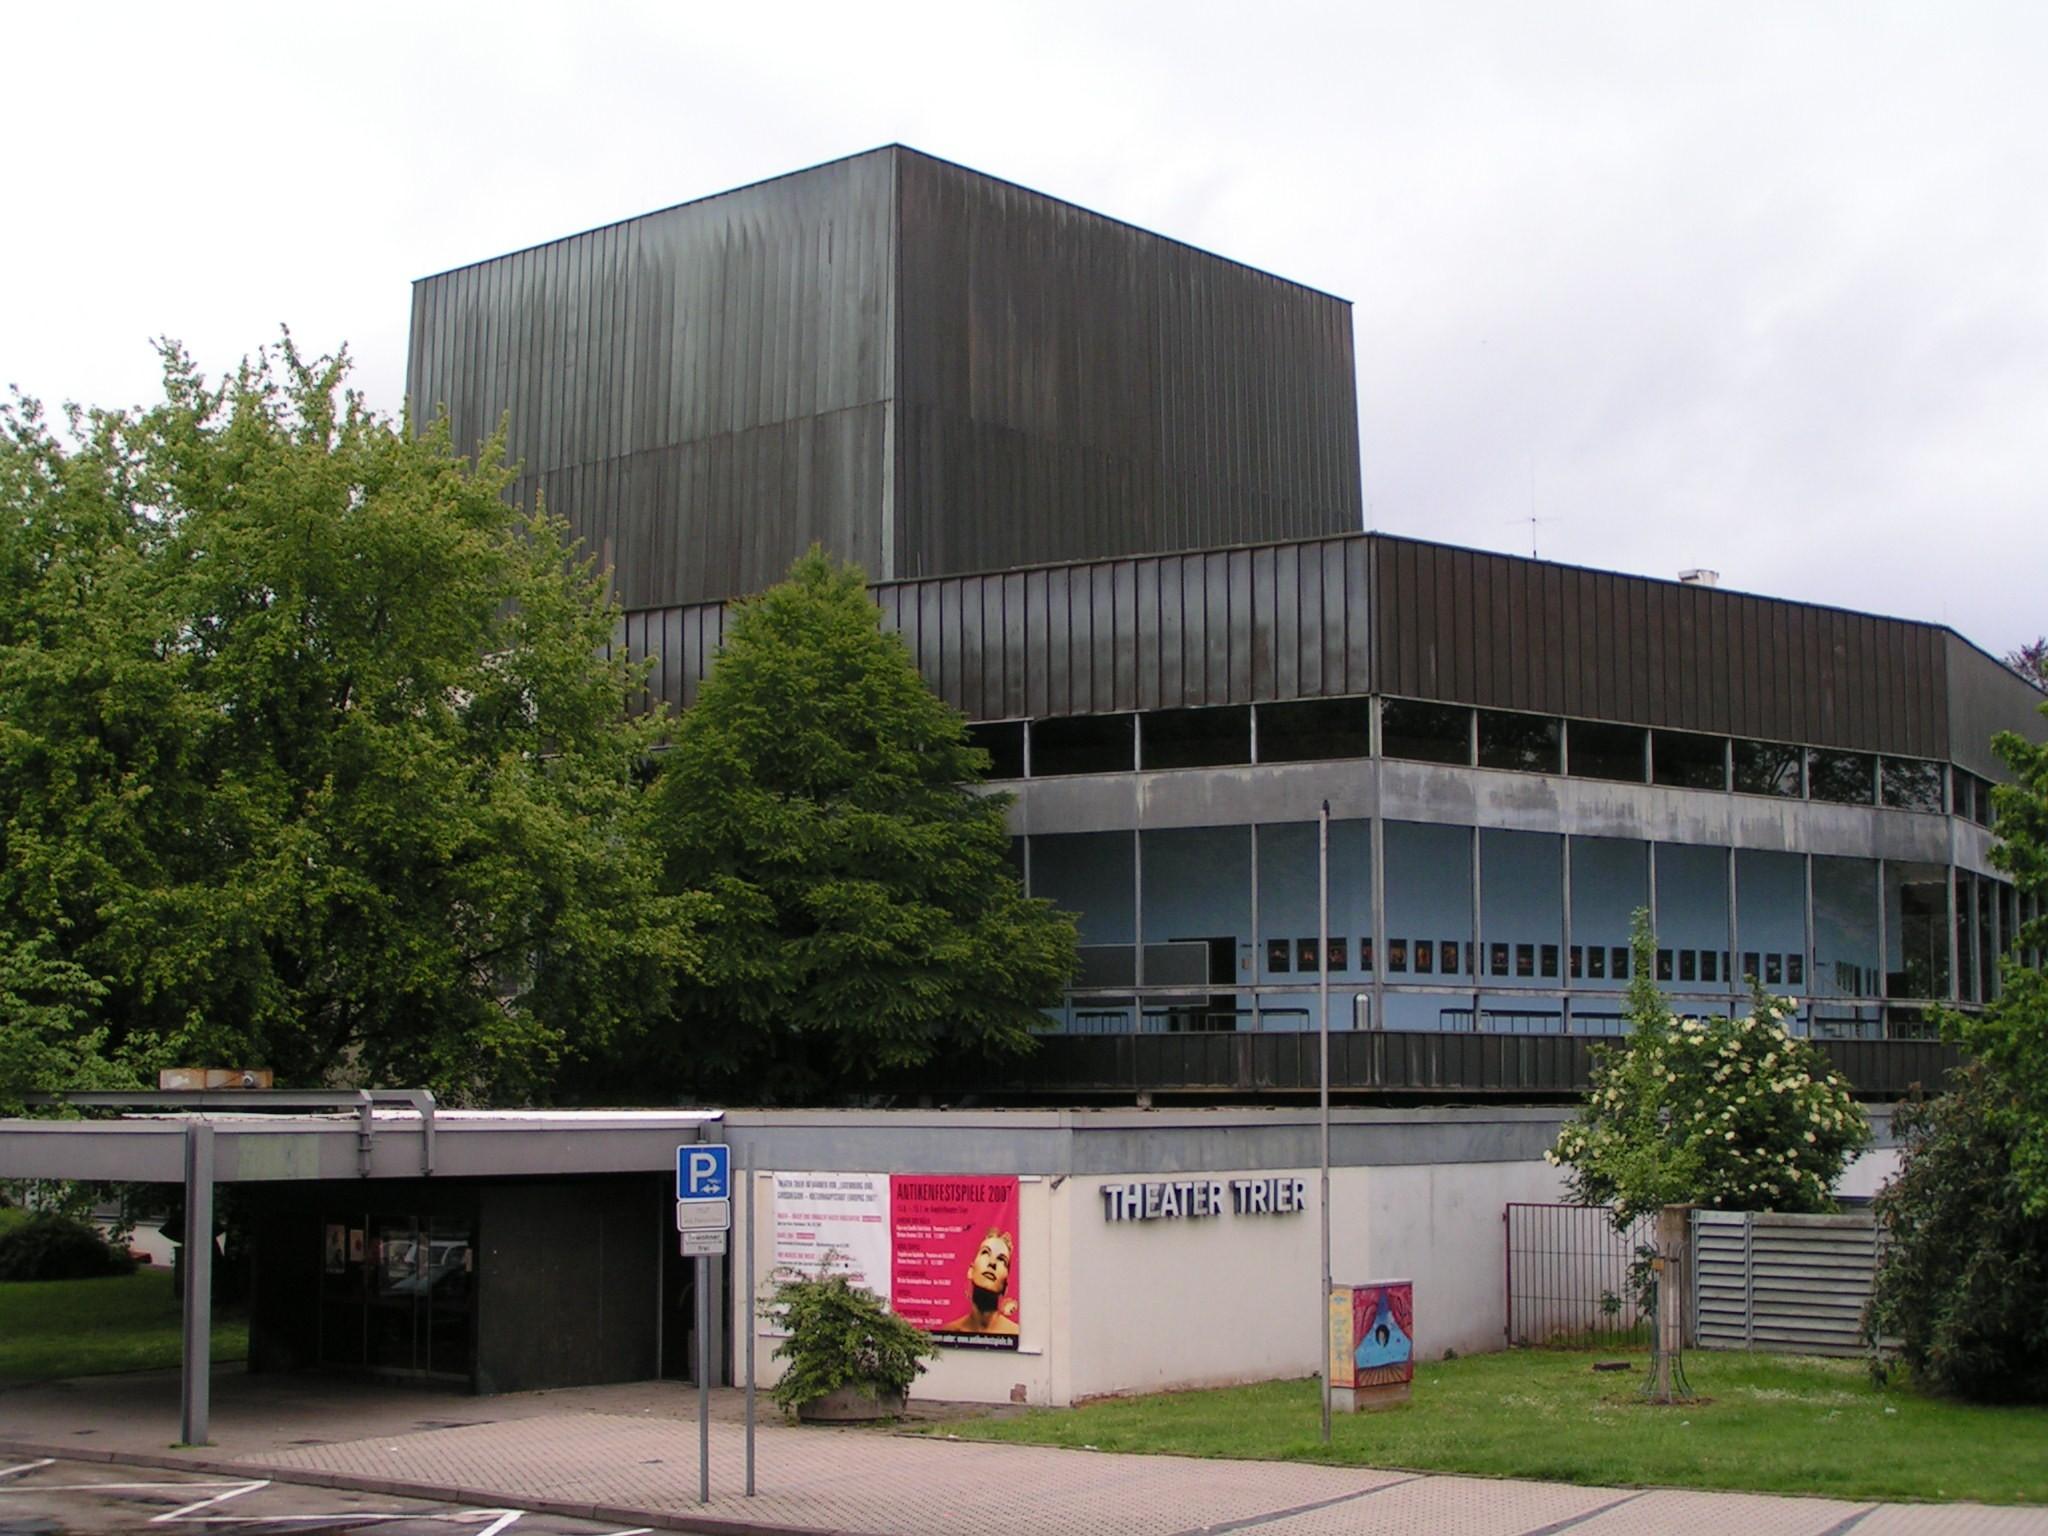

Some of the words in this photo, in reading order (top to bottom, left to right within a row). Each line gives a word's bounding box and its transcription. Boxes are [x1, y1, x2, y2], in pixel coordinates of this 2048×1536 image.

[690, 1152, 717, 1193] P
[897, 1183, 985, 1202] ANTIKENFESTSPIELE
[987, 1185, 1012, 1203] 2007
[1102, 1181, 1224, 1222] THEATER
[1230, 1178, 1307, 1215] TRIER
